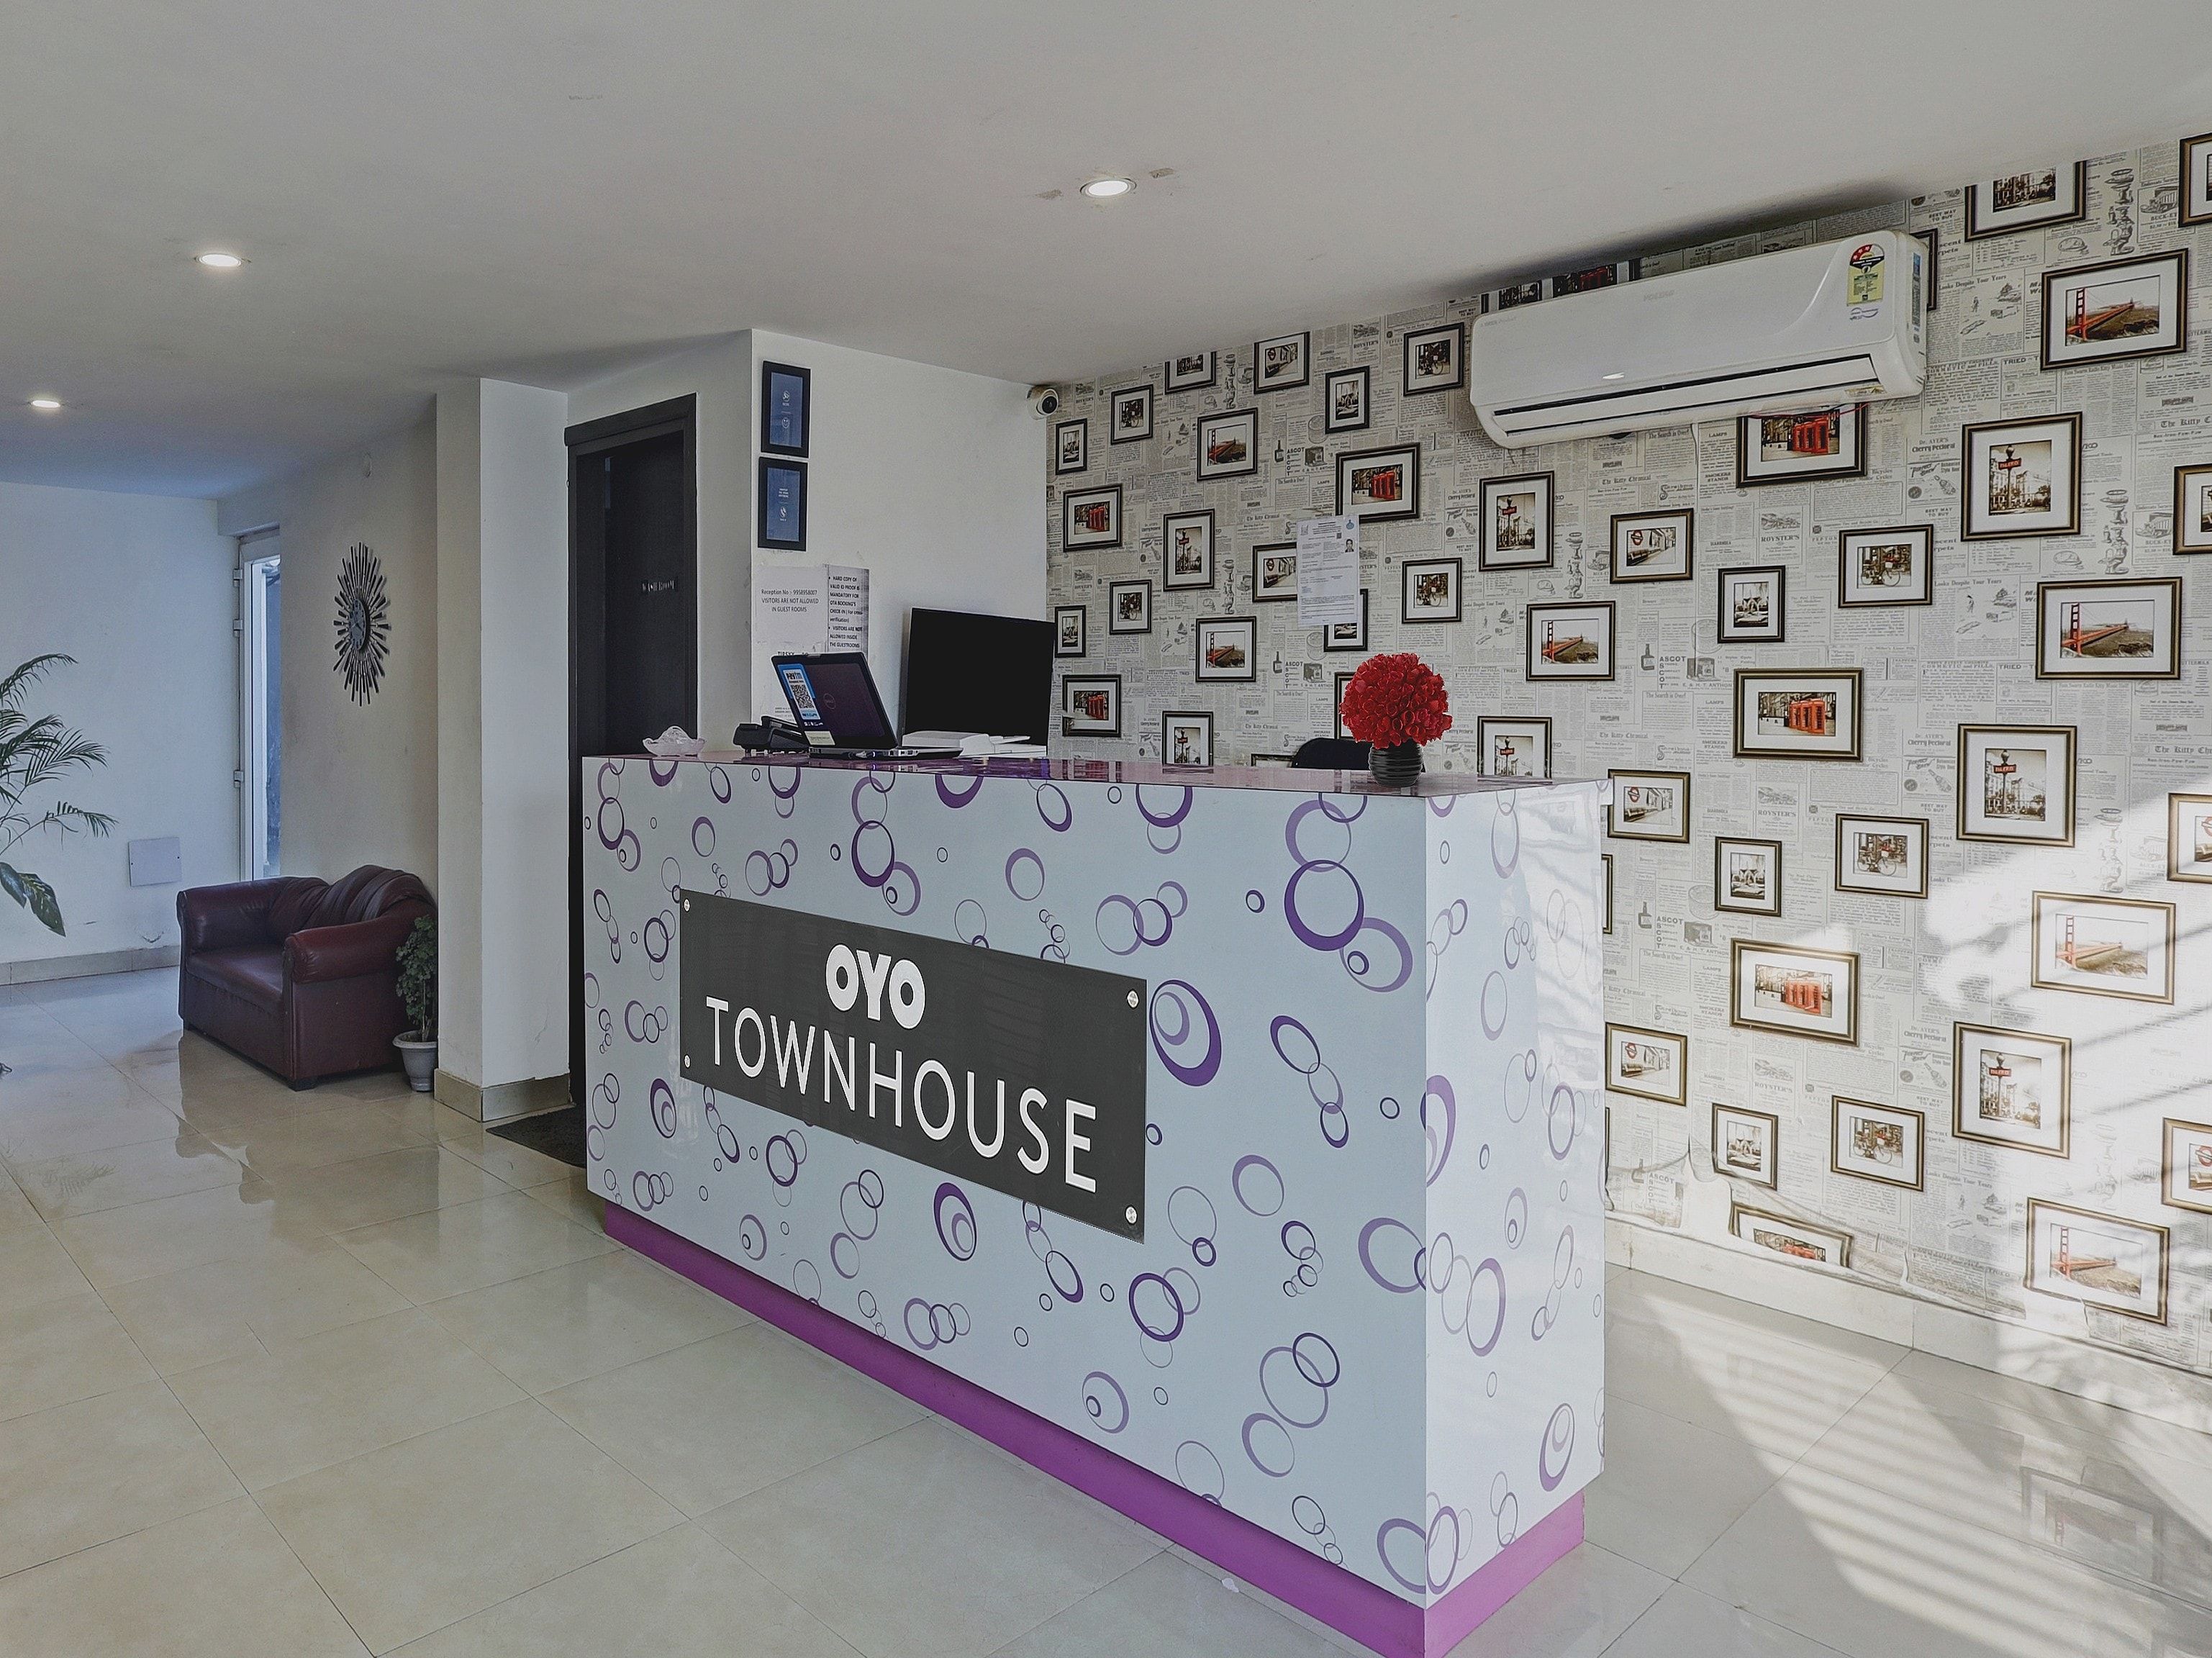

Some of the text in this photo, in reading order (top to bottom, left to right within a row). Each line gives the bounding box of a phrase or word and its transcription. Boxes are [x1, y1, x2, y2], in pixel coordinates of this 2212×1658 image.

[1657, 916, 1684, 925] ASCOT
[825, 943, 926, 1029] OYO
[1754, 1082, 1793, 1094] ROYSTER'S
[706, 996, 1096, 1193] TOWNHOUSE
[1649, 1172, 1675, 1184] ASCOT
